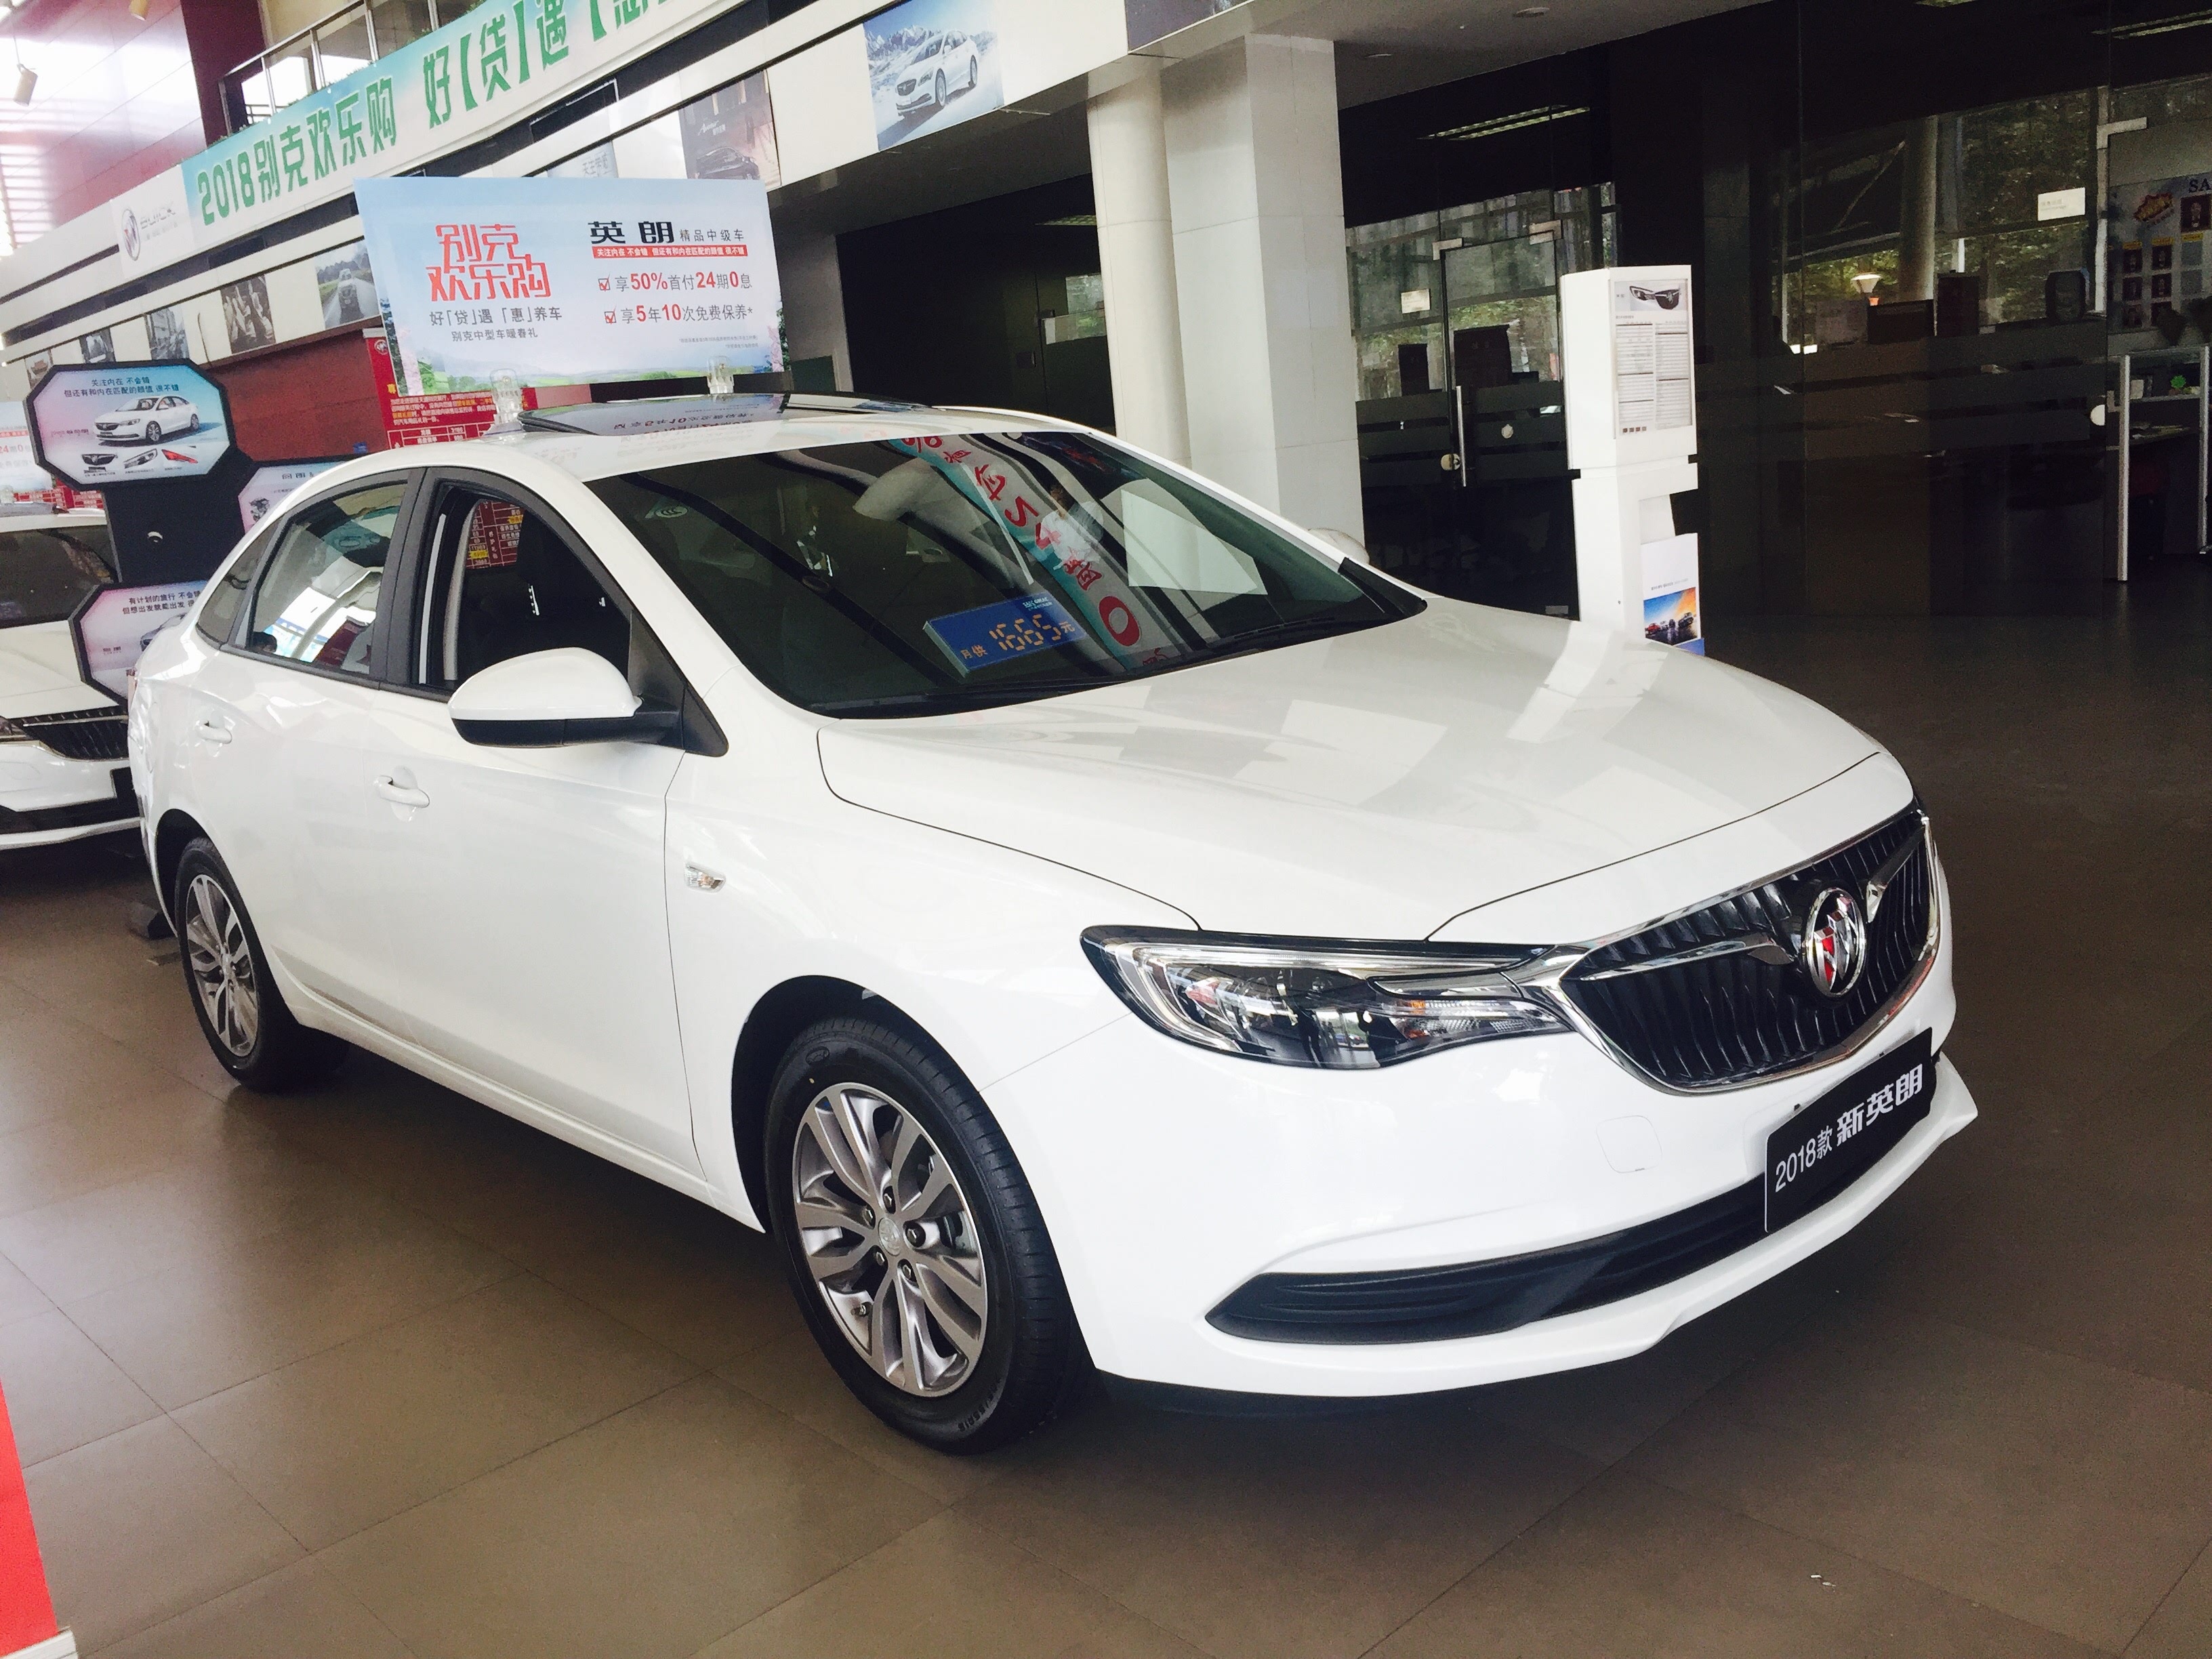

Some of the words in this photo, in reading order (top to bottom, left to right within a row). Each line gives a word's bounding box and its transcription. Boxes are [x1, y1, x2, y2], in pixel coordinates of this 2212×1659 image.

[197, 75, 396, 226] 2018别克欢乐购
[435, 224, 519, 263] 别克
[588, 221, 675, 245] 英朗
[679, 228, 745, 242] 精品中级车
[426, 260, 552, 302] 欢乐购
[614, 271, 753, 292] 享50%首付24期0息
[451, 328, 538, 342] 别克中型车暖春礼
[960, 644, 988, 659] 月供
[989, 613, 1062, 651] 1665
[1059, 621, 1076, 634] 元
[1775, 1125, 1832, 1193] 2018款
[1836, 1063, 1923, 1147] 新英朗
